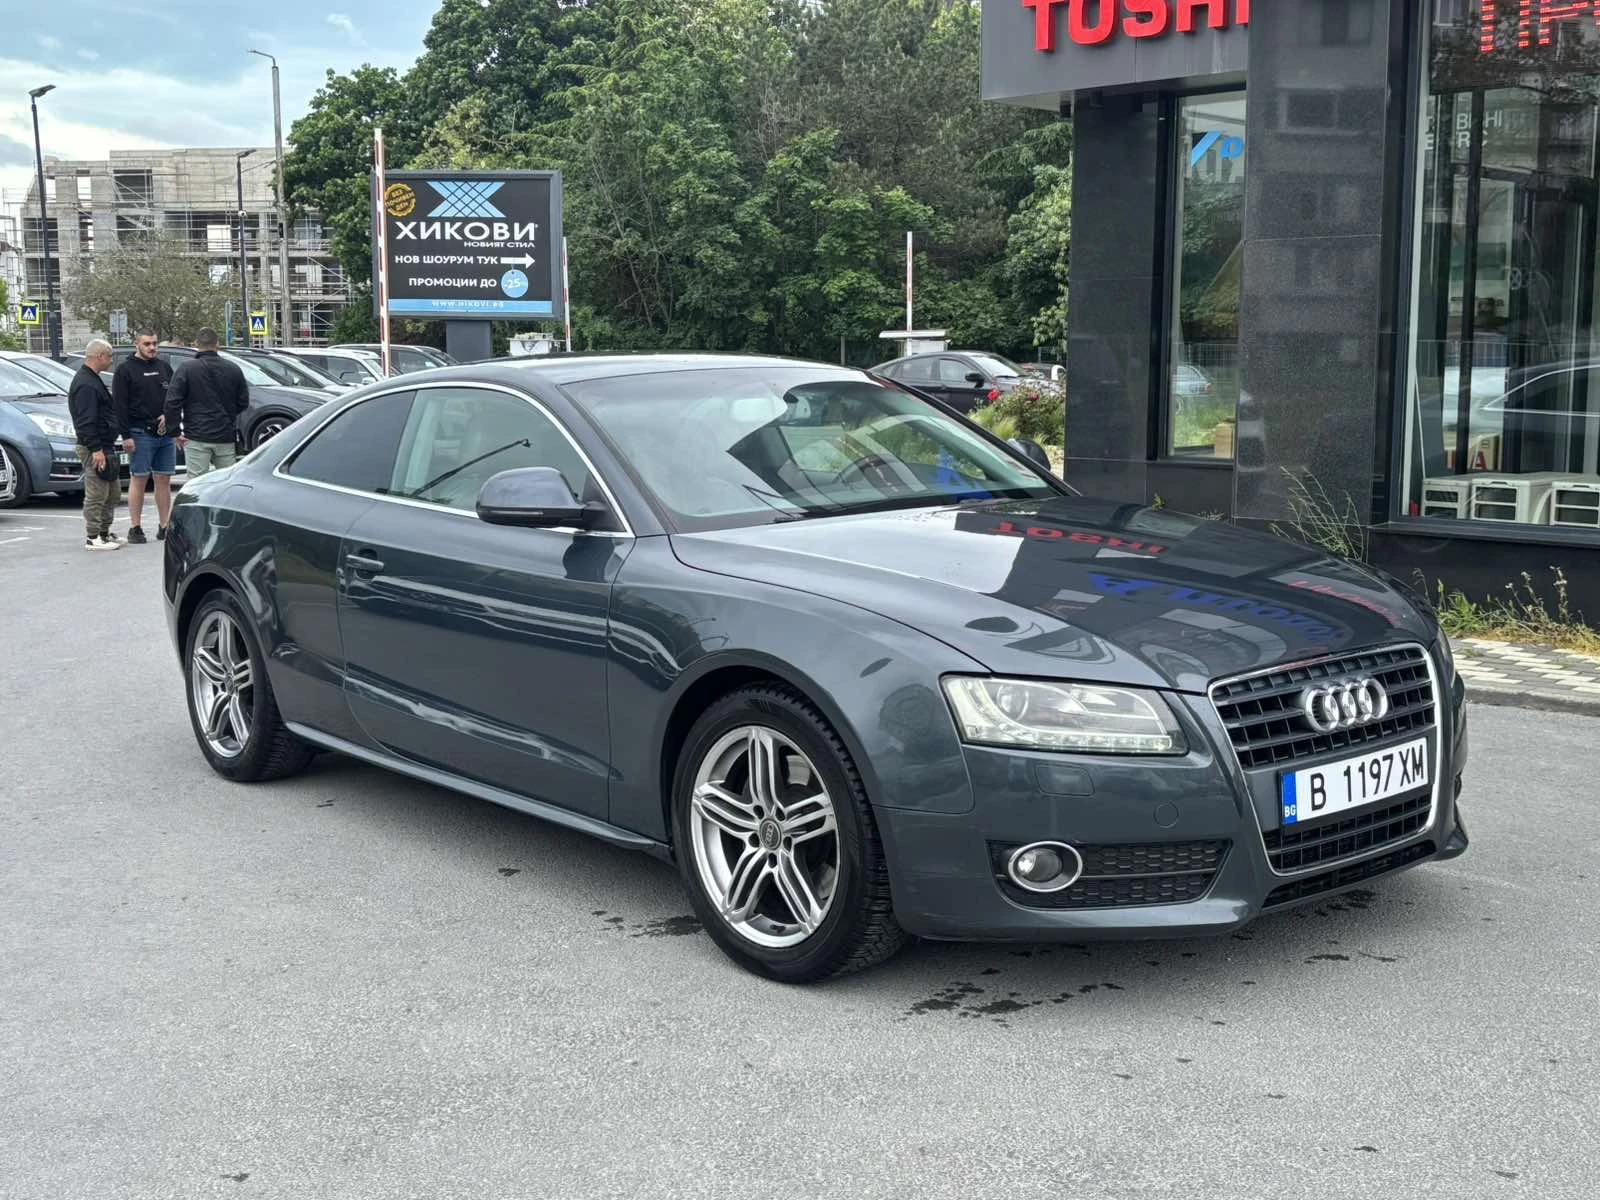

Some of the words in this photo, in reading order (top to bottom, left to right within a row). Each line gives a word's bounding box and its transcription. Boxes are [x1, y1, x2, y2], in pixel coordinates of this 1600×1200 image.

[395, 221, 535, 241] ХИКОВИ
[394, 255, 420, 264] НОВ
[422, 255, 474, 265] ШОУРУМ
[476, 255, 498, 265] ТУК
[408, 277, 478, 288] ПРОМОЦИИ
[479, 278, 497, 288] ДО
[1310, 772, 1327, 812] B
[1343, 753, 1395, 803] 1197
[1398, 744, 1425, 787] XM
[1283, 805, 1296, 818] BG
